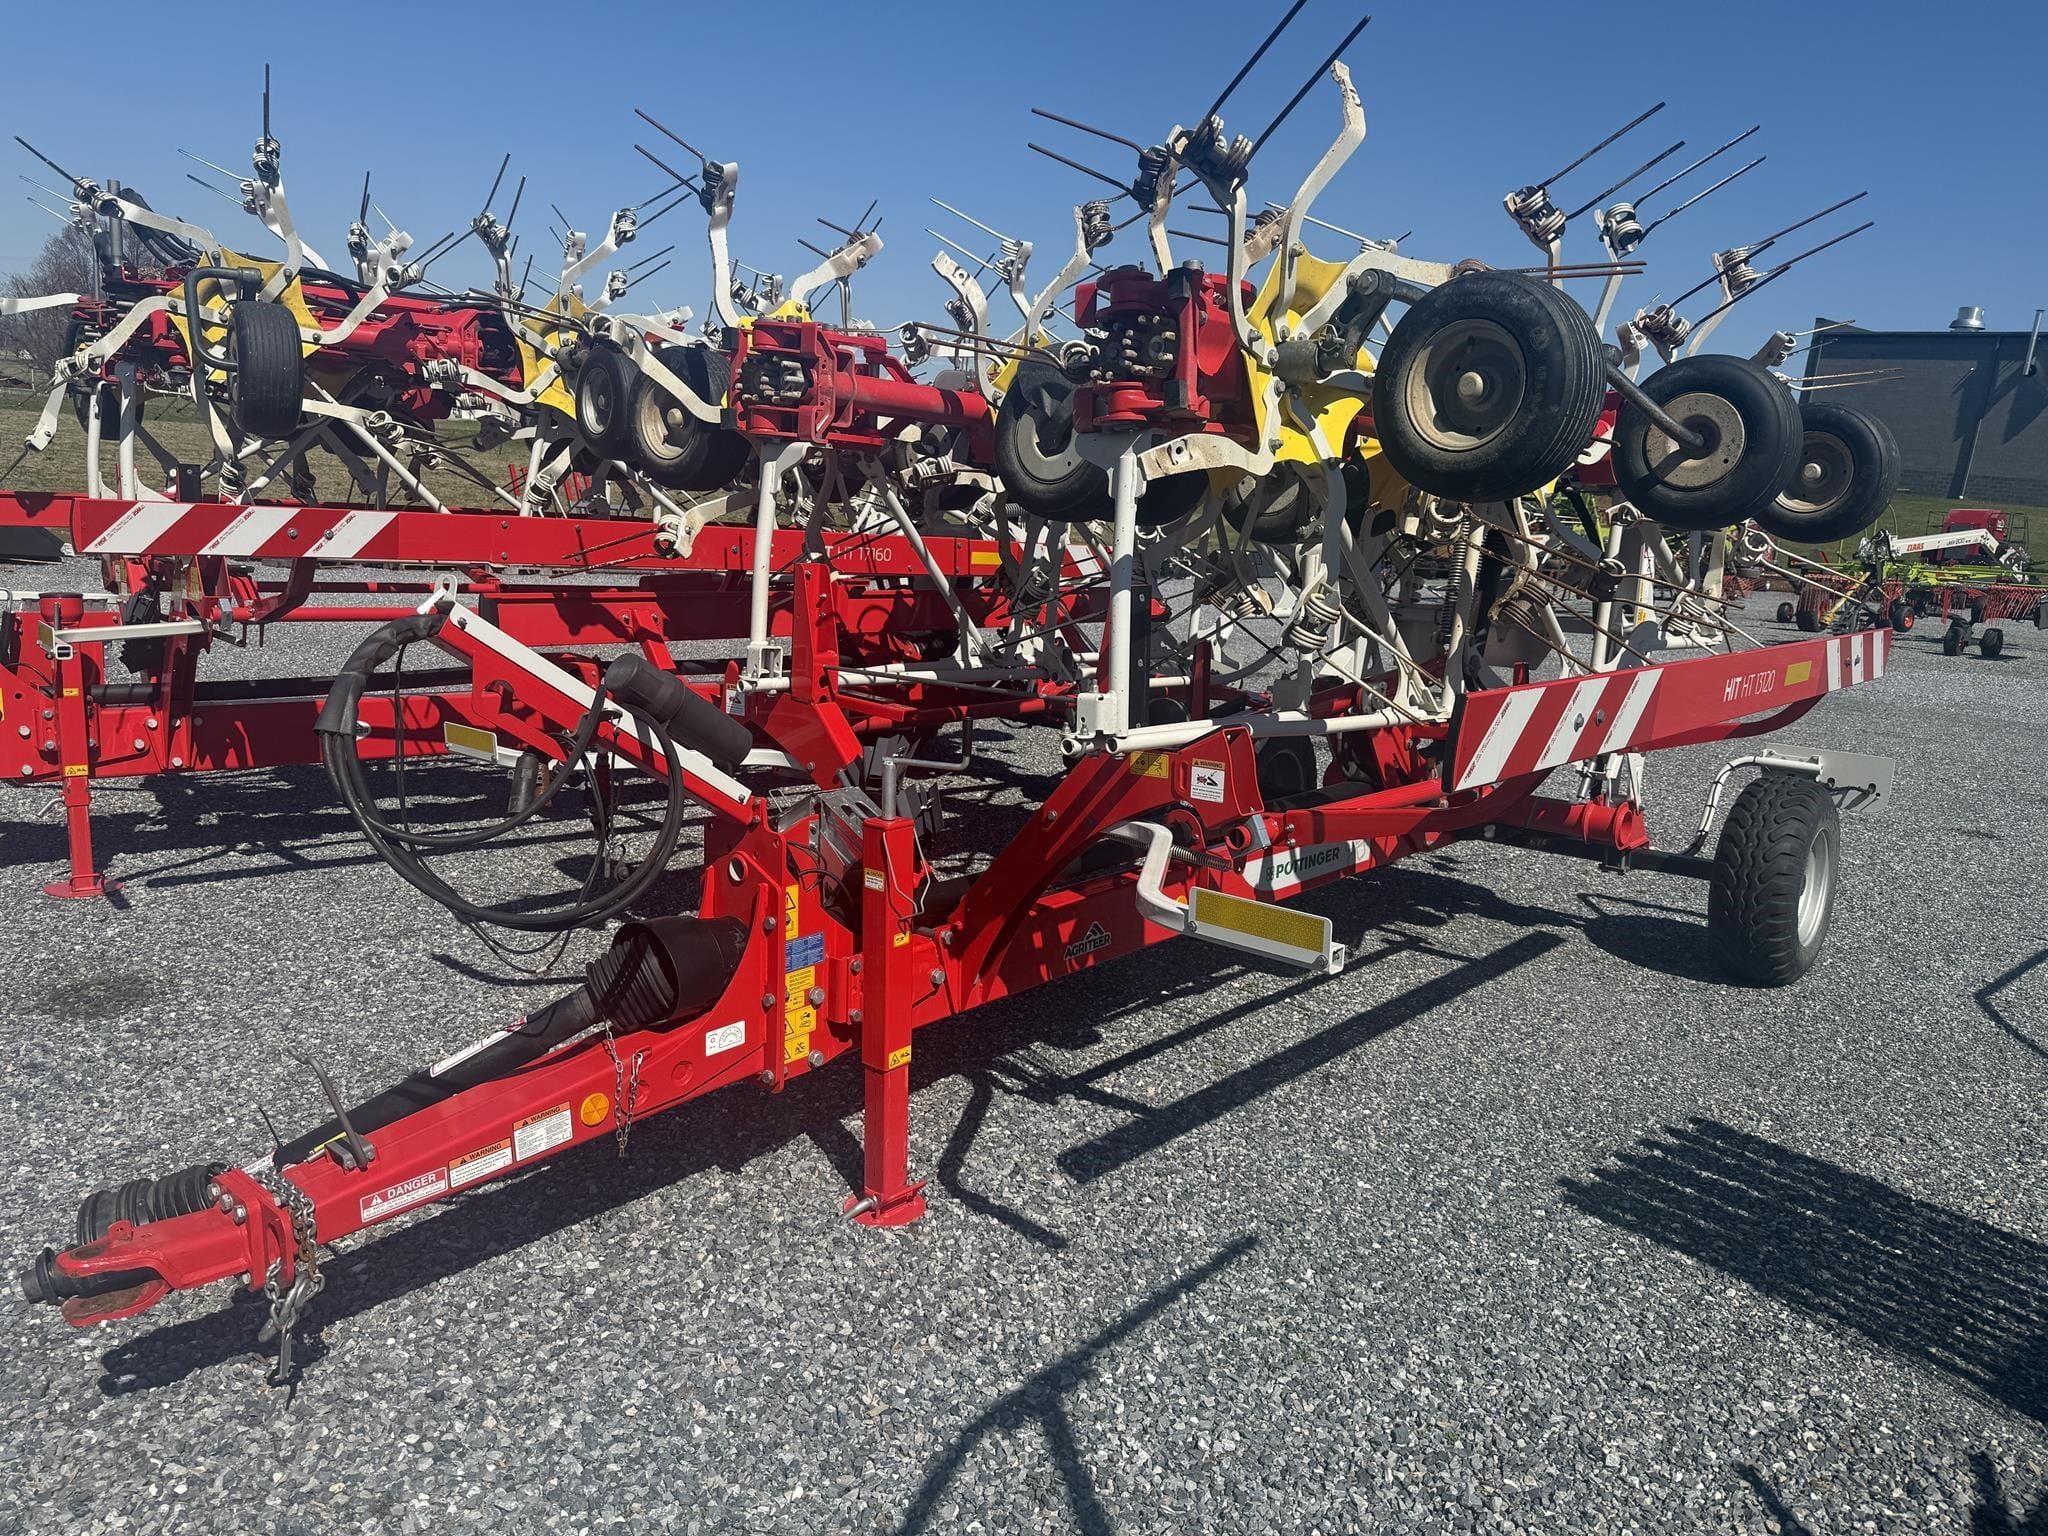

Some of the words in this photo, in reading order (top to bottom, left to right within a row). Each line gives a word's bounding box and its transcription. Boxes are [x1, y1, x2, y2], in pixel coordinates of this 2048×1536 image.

[859, 547, 892, 562] 17160
[1723, 677, 1743, 702] HIT
[1740, 675, 1756, 698] HT
[1755, 669, 1776, 695] 13120
[1065, 933, 1110, 959] AGRITEER
[530, 1106, 561, 1122] WARNING
[469, 1143, 502, 1160] WARNING
[387, 1173, 437, 1199] DANGER
